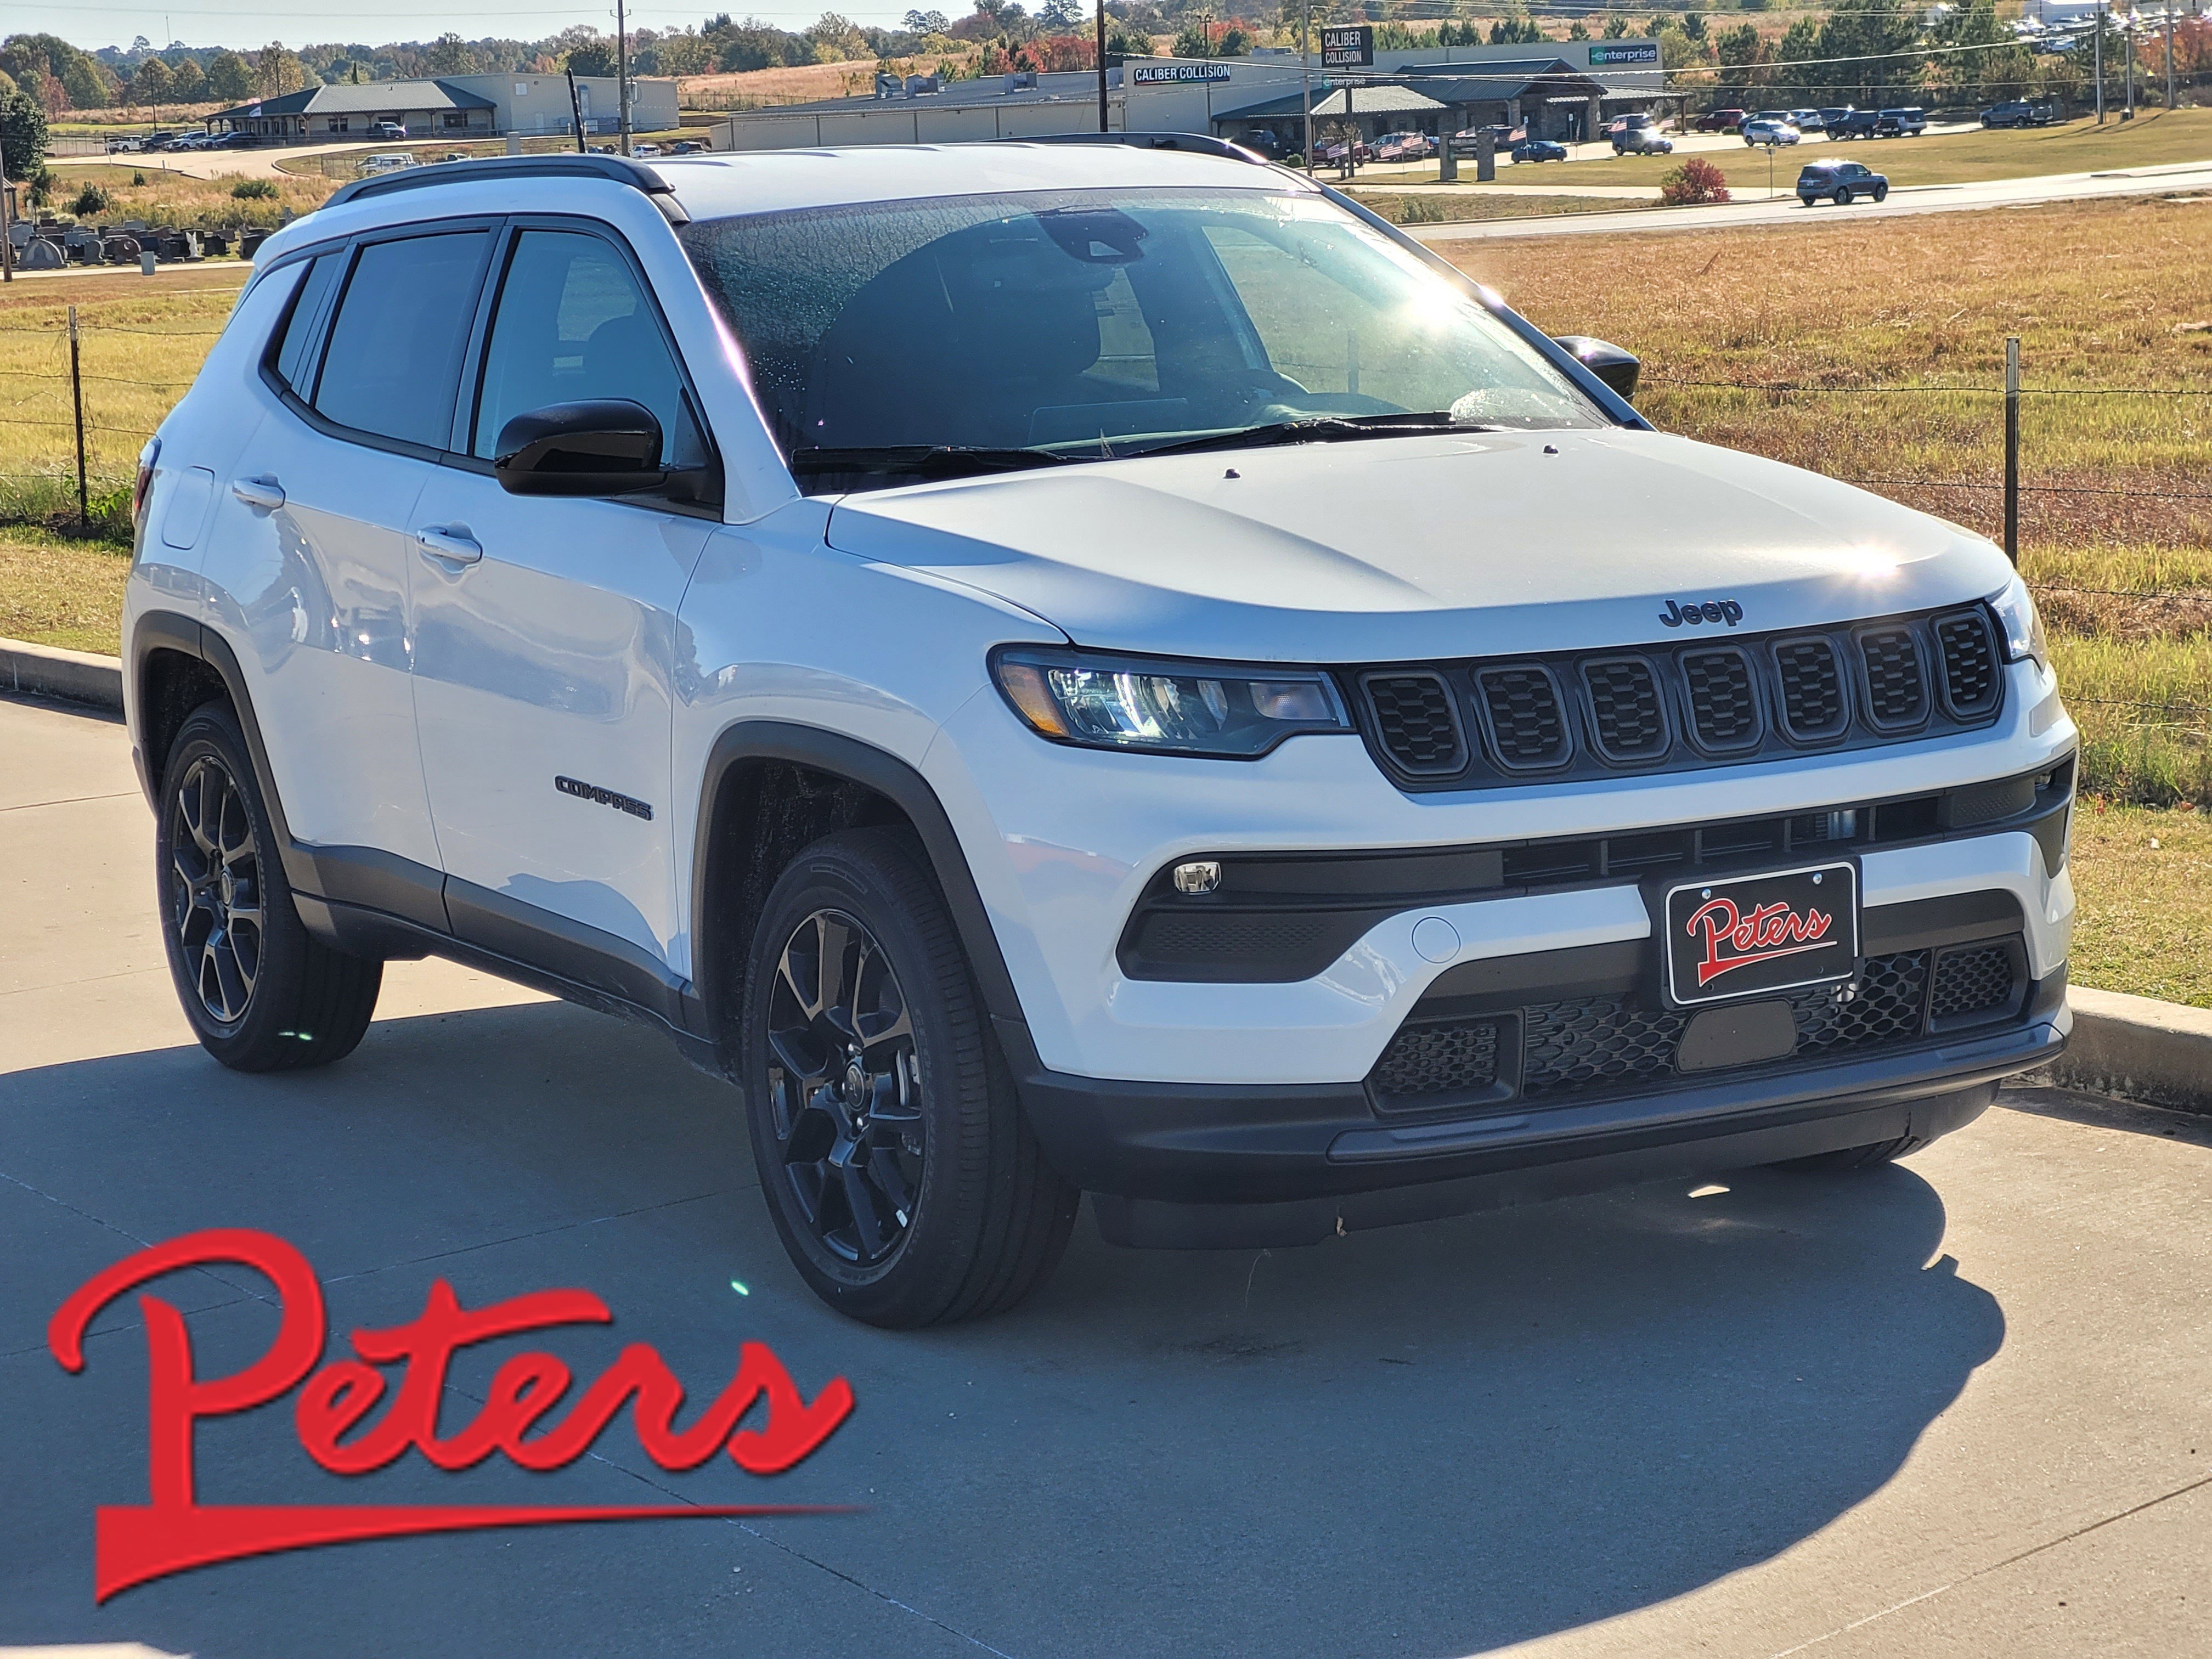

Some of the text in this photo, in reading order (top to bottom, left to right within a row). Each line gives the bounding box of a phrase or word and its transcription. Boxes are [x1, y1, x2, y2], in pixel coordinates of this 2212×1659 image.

[1325, 31, 1361, 47] CALIBER
[1325, 50, 1362, 64] COLLISION
[1592, 48, 1656, 61] enterprise
[1135, 65, 1231, 81] CALIBER COLLISION
[1323, 78, 1365, 87] enterprise
[1658, 599, 1743, 627] Jeep
[555, 775, 654, 821] COMPASS
[1686, 898, 1832, 966] Peters
